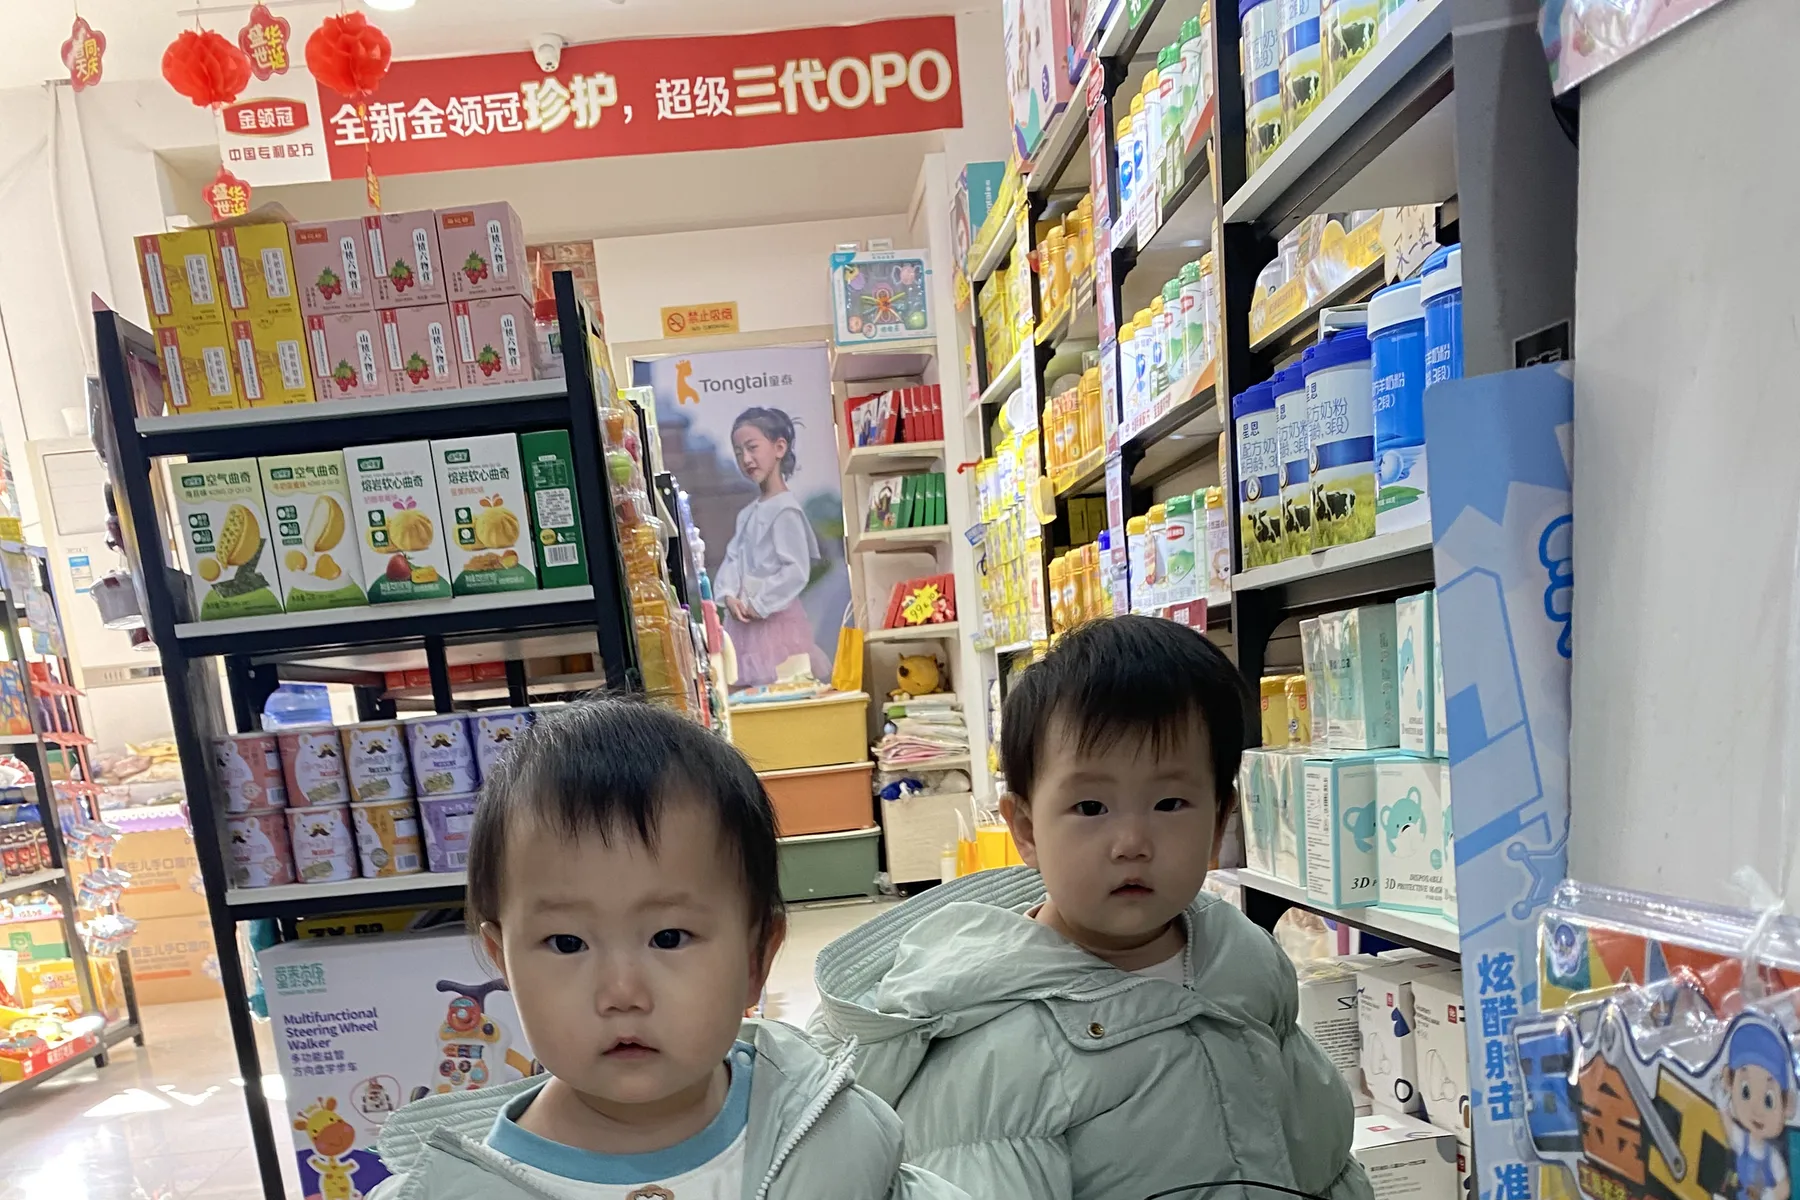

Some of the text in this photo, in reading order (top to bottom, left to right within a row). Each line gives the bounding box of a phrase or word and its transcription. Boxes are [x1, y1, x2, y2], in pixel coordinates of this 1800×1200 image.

[238, 107, 294, 130] 金领冠
[229, 143, 314, 162] 中国专利配方
[688, 307, 733, 323] 禁止吸烟
[698, 372, 794, 395] Tongtai 童泰
[206, 471, 251, 486] 空气曲奇
[294, 464, 339, 479] 空气曲奇
[448, 467, 510, 486] 熔岩软心曲奇
[361, 474, 424, 493] 熔岩软心曲奇
[1351, 877, 1370, 890] 3D
[1384, 878, 1396, 890] 3D
[283, 1007, 378, 1025] Multifunctional
[286, 1020, 379, 1038] Steering Wheel
[287, 1038, 331, 1051] Walker
[291, 1050, 344, 1064] 多功能益智
[293, 1062, 358, 1077] 方向盘学步车
